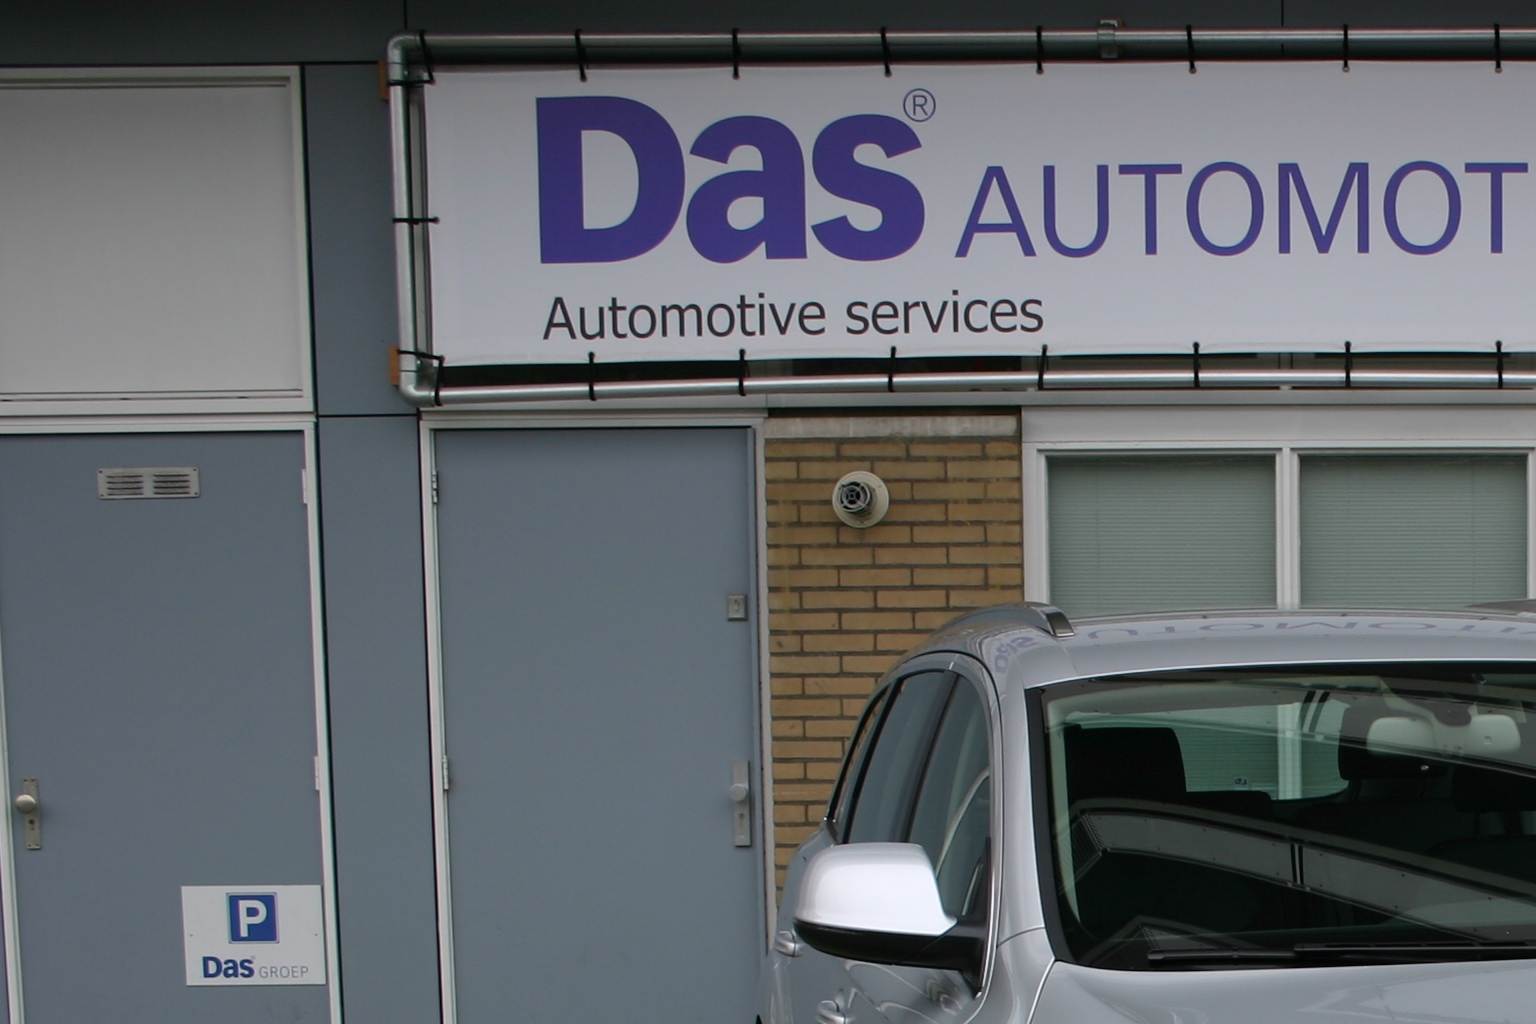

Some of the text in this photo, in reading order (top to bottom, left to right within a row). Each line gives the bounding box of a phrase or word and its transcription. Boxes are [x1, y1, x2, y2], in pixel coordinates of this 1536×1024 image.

[543, 290, 1043, 340] Automotive services
[238, 899, 268, 937] P
[202, 956, 309, 979] Das GROEP
